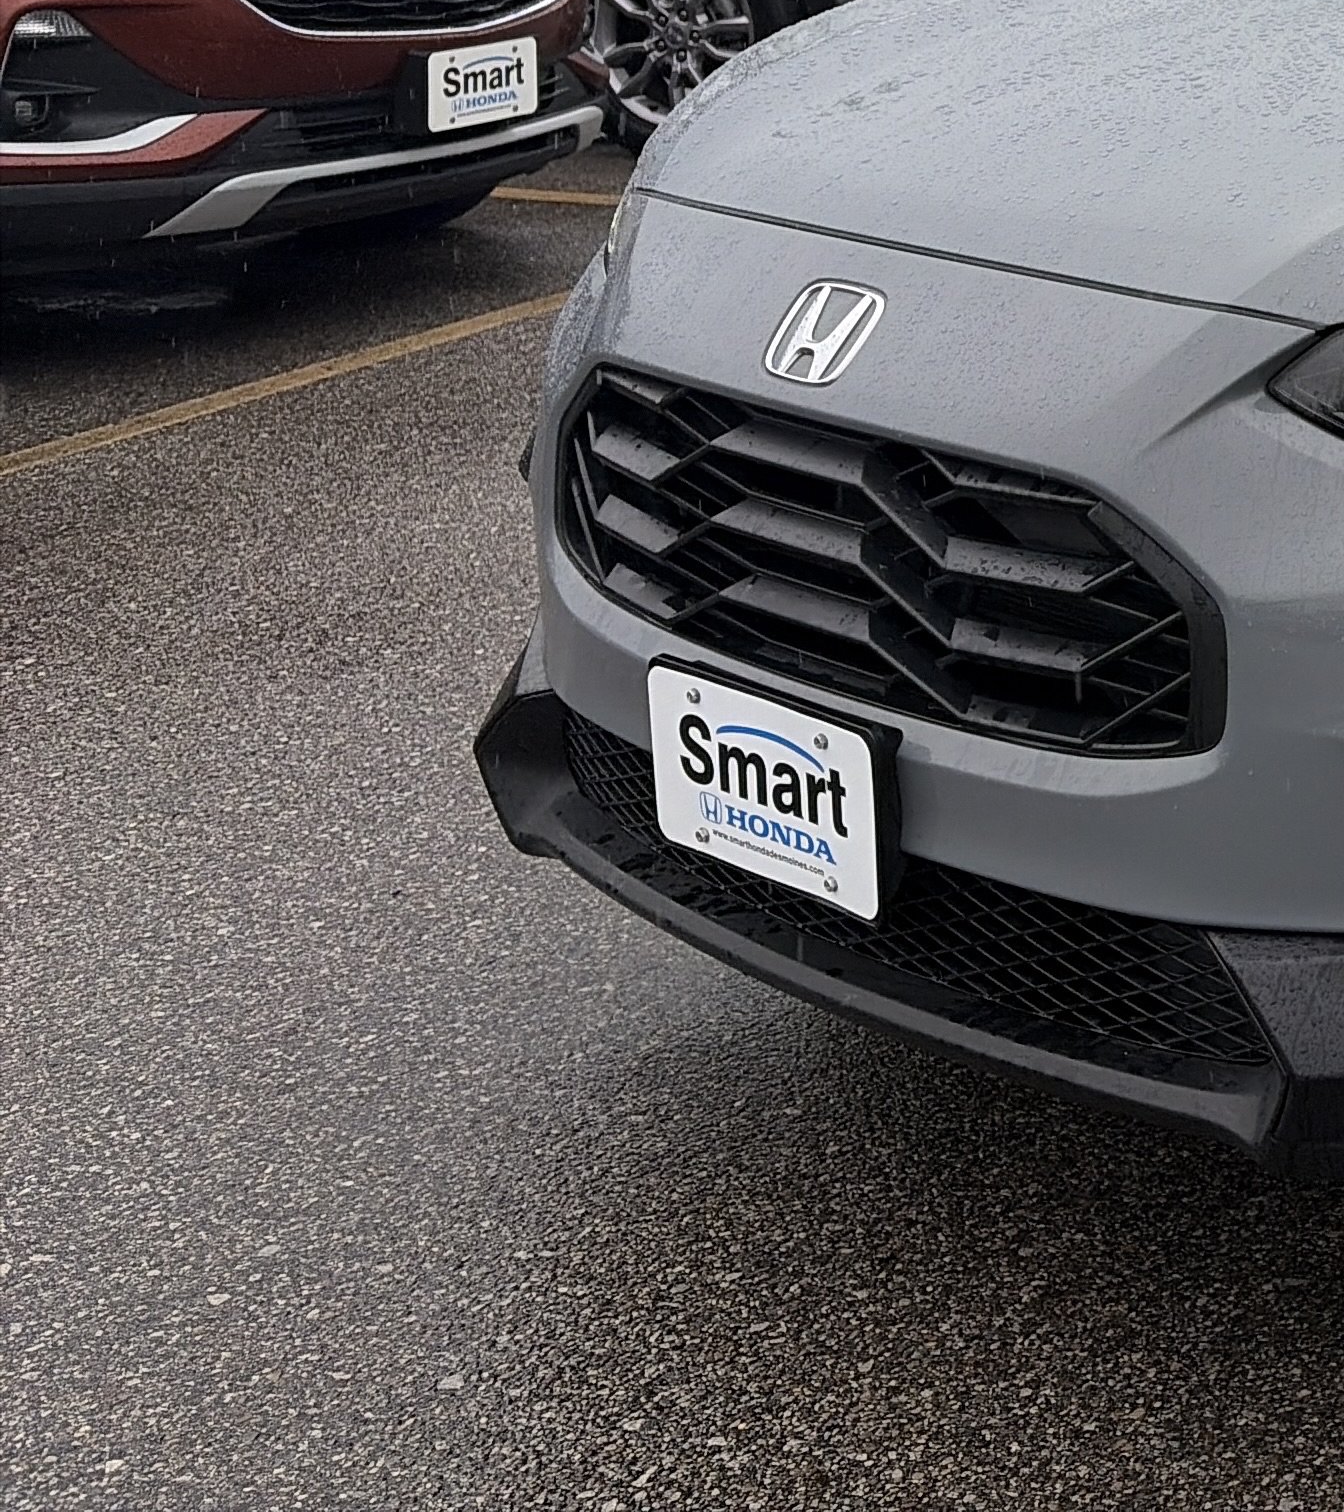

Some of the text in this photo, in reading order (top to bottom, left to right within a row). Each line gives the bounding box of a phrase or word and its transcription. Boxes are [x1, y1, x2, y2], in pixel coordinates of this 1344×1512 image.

[443, 57, 525, 98] Smart
[466, 91, 518, 109] HONDA
[679, 714, 849, 838] Smart
[725, 804, 837, 866] HONDA
